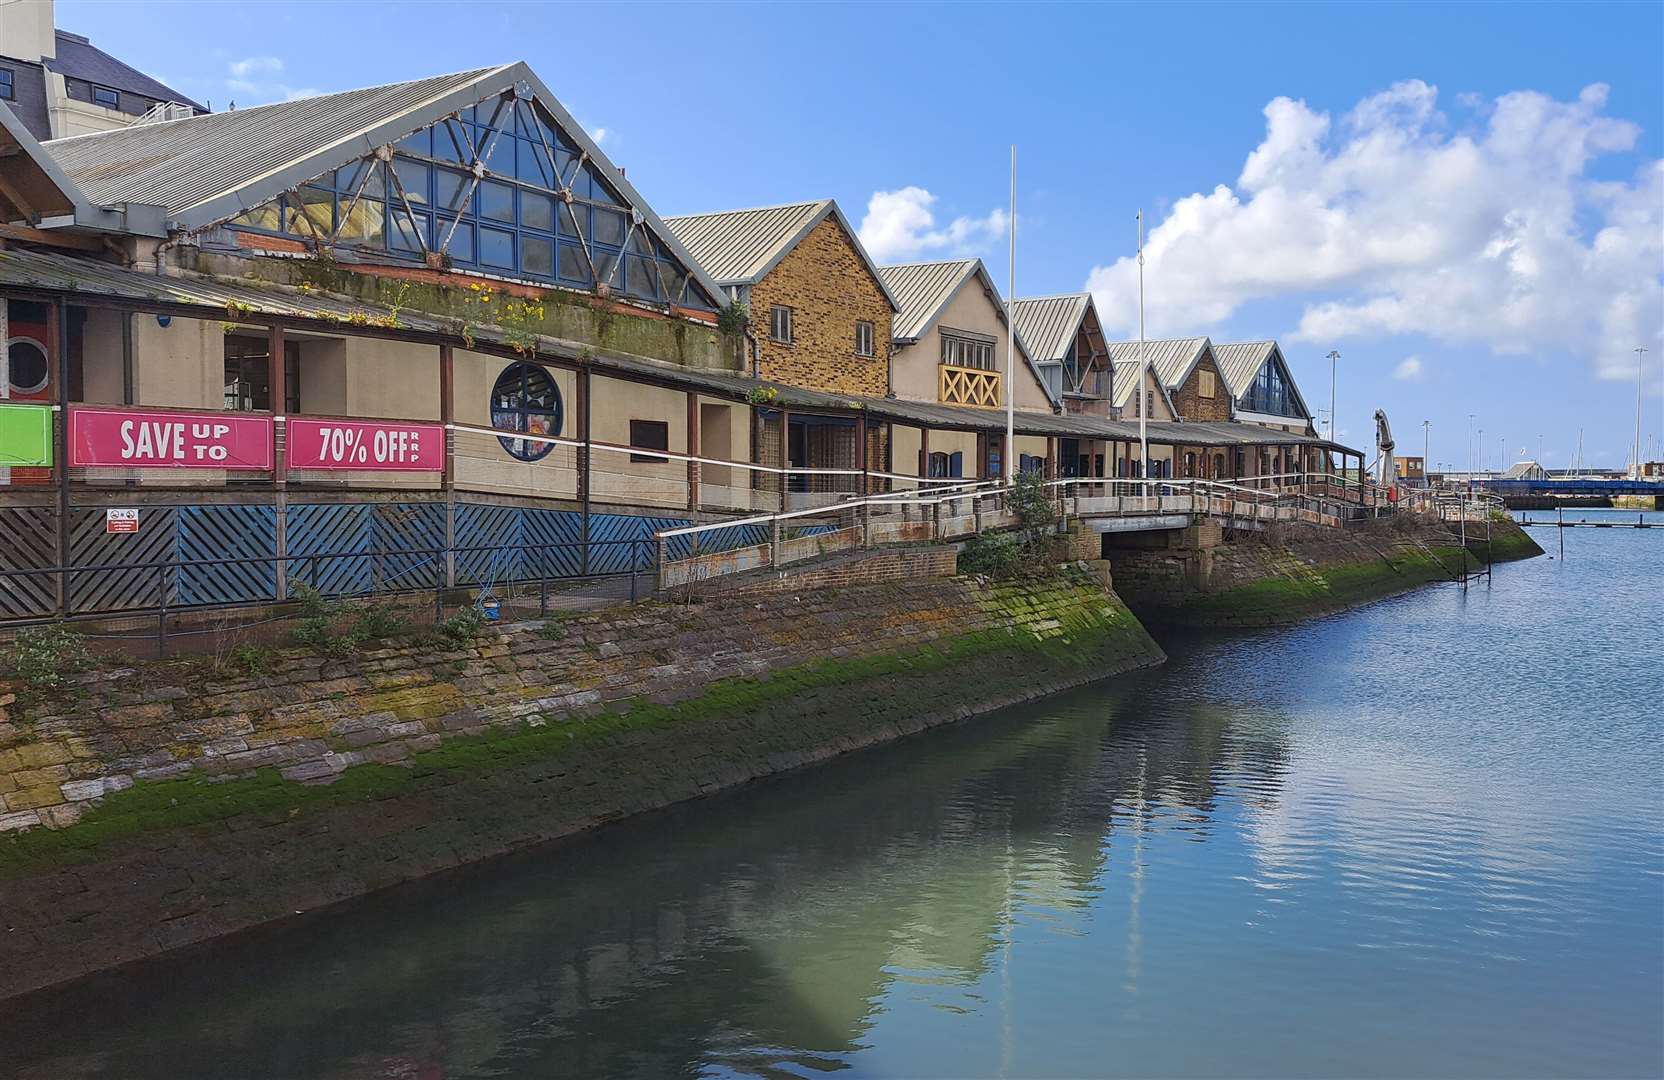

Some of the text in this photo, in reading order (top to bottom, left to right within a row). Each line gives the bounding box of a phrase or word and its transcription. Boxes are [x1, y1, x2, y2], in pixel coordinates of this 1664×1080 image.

[120, 420, 230, 459] SAVE UP
[193, 445, 228, 460] TO
[319, 428, 408, 463] 70% OFF
[411, 431, 420, 463] RRP
